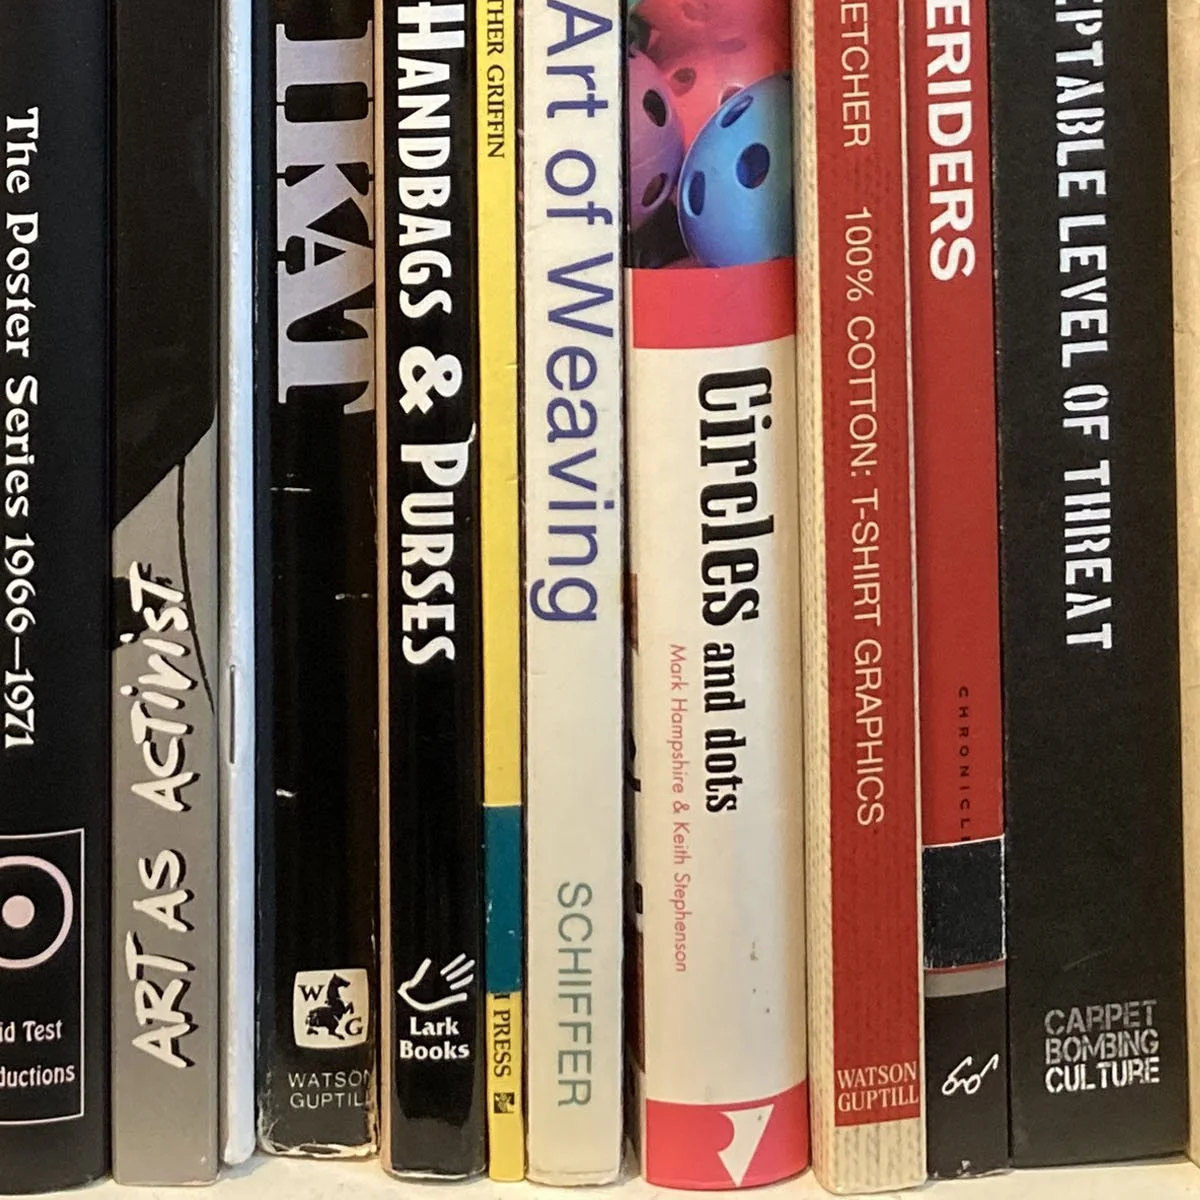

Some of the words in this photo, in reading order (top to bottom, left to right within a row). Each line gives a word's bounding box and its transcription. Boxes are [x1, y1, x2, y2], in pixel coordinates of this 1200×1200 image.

[5, 107, 39, 194] The
[486, 64, 506, 159] GRIFFIN
[397, 3, 465, 319] HANDBAGS
[545, 148, 614, 224] of
[276, 19, 376, 416] IKAT
[845, 207, 875, 302] 100%
[5, 211, 39, 358] Poster
[1058, 214, 1109, 368] LEVEL
[530, 252, 615, 622] Weaving
[846, 316, 879, 477] COTTON:
[1062, 384, 1110, 440] OF
[5, 374, 39, 518] Series
[698, 367, 774, 626] Circles
[401, 438, 470, 665] PURSES
[851, 491, 881, 626] T-SHIRT
[1064, 460, 1112, 649] THREAT
[670, 644, 688, 691] Mark
[703, 642, 746, 712] and
[667, 698, 689, 793] Hampshire
[705, 728, 747, 814] dots
[854, 639, 885, 826] GRAPHICS
[133, 849, 194, 932] AS
[672, 822, 692, 865] Keith
[667, 872, 691, 973] Stephenson
[126, 931, 197, 1068] ART
[410, 1017, 460, 1036] Lark
[557, 881, 592, 1107] SCHIFFER
[1045, 1000, 1157, 1035] CARPET
[400, 1040, 470, 1060] Books
[493, 1008, 512, 1077] PRESS
[838, 1061, 917, 1089] WATSON
[1045, 1028, 1159, 1066] BOMBING
[1045, 1057, 1160, 1093] CULTURE
[838, 1084, 919, 1113] GUPTILL
